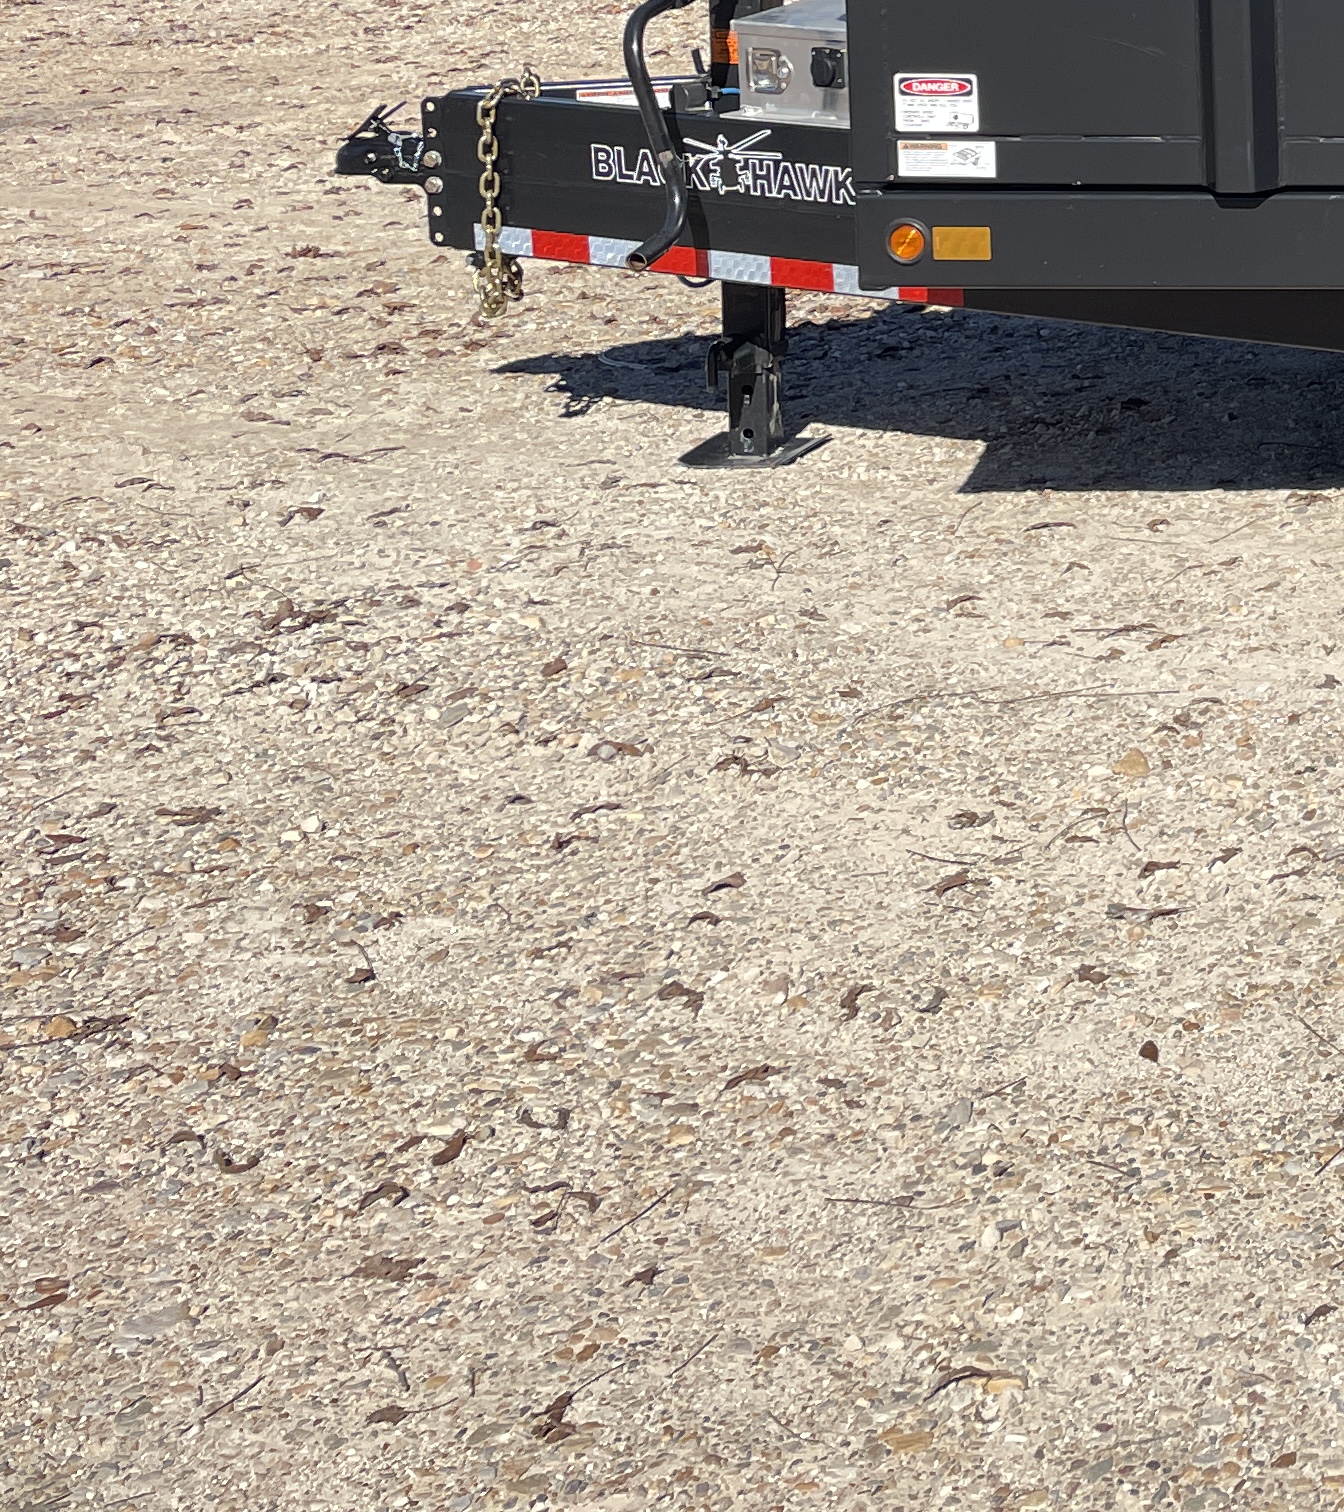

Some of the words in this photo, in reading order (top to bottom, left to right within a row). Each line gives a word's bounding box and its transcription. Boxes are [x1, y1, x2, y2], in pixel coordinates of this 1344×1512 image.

[911, 82, 960, 92] DANGER
[590, 143, 712, 191] BLAK
[748, 159, 857, 206] HAWK
